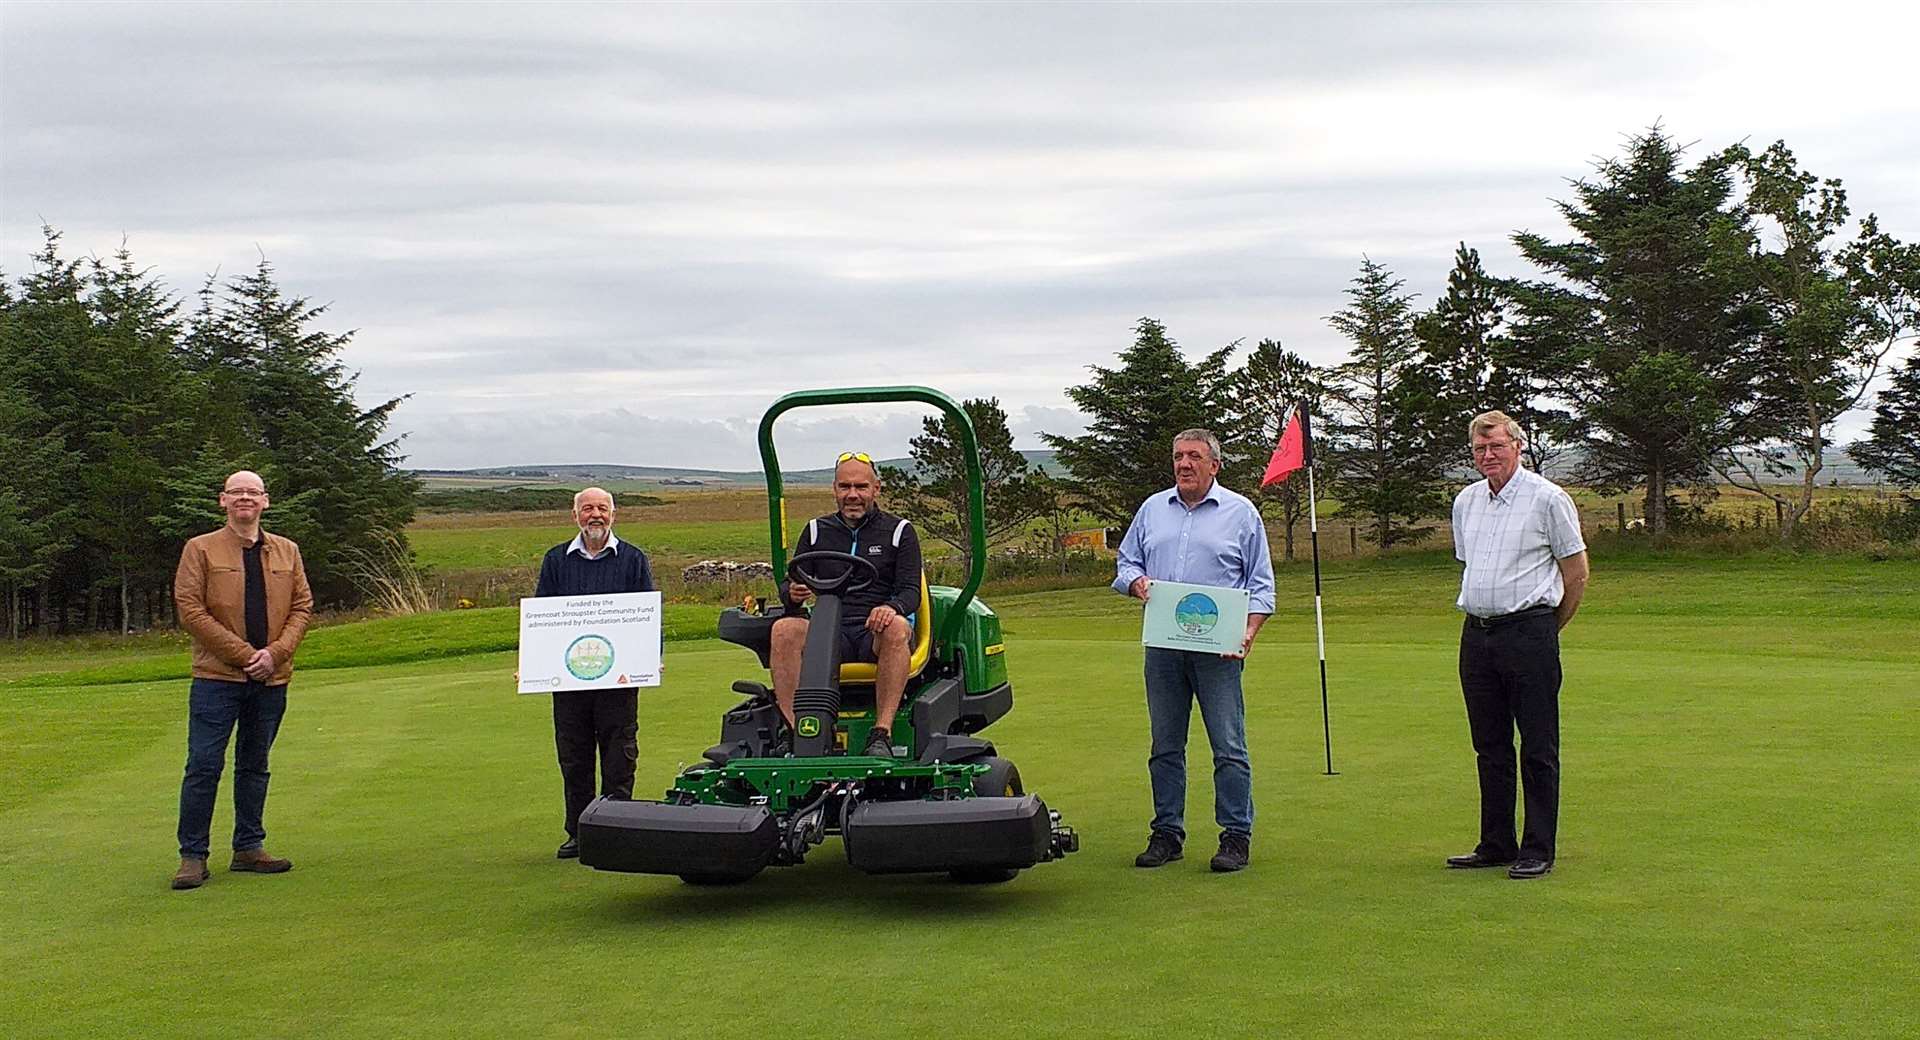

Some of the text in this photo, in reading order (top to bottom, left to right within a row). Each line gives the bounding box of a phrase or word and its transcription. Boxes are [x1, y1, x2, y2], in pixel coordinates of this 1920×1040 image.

[592, 600, 601, 608] by
[528, 615, 650, 628] administered by Foundation Scotland
